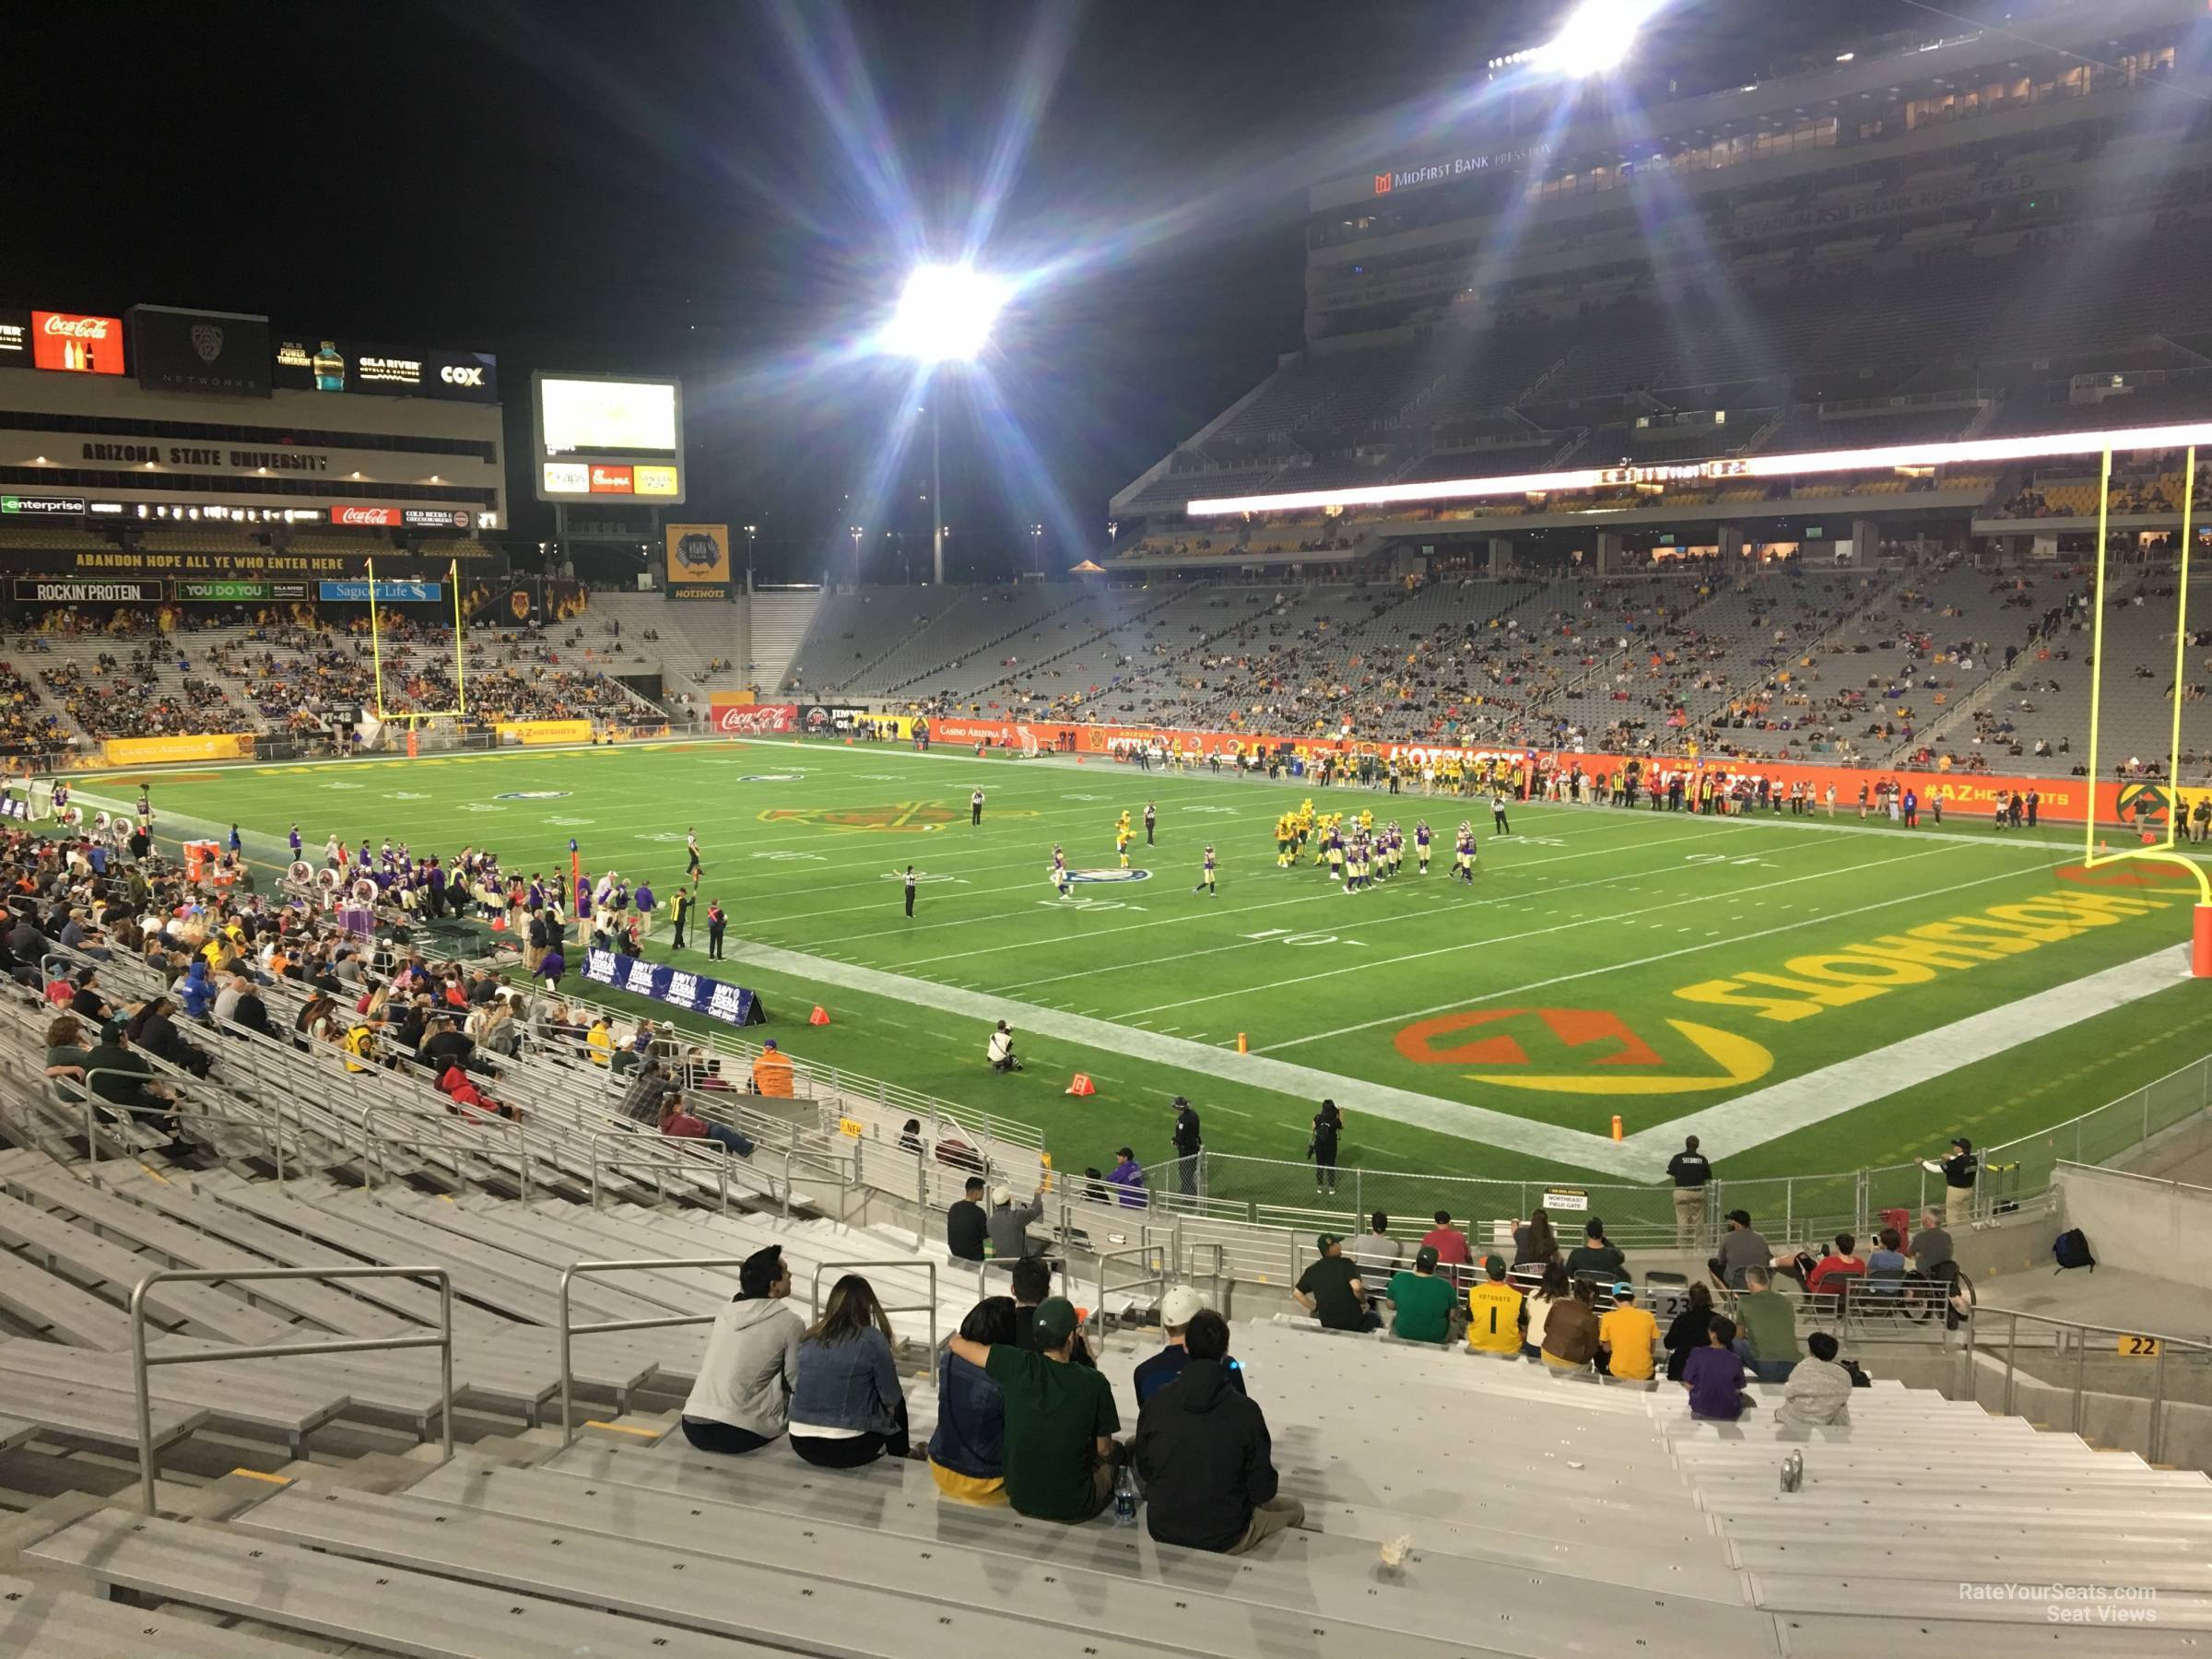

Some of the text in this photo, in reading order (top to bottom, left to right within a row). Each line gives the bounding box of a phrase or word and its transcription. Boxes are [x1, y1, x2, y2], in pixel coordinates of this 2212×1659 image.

[1454, 155, 1488, 174] BANK
[1980, 173, 2033, 198] FIELD
[44, 314, 110, 339] Coca-Cola
[191, 325, 224, 344] PAC
[200, 346, 216, 358] 12
[280, 347, 306, 358] POWER
[276, 356, 311, 367] THROUGH
[359, 357, 419, 371] GILA RIVER
[163, 373, 256, 390] NETWORKS
[441, 365, 482, 386] COX
[83, 442, 328, 471] ARIZONA STATE UNIVERSITY
[6, 500, 83, 512] enterprise
[343, 507, 391, 524] Coca-Cola
[76, 554, 344, 571] ABANDON HOPE ALL YE WHO ENTER HERE
[87, 584, 140, 600] PROTEIN
[186, 585, 263, 596] YOU DO YOU
[385, 584, 407, 597] Life
[676, 590, 724, 598] HOTSHOTS
[940, 724, 1000, 739] CASINO ARIZONA
[120, 744, 205, 756] CASINO ARIZONA
[632, 959, 650, 972] NAVY
[629, 970, 653, 984] FEDERAL
[673, 971, 691, 984] NAVY
[625, 982, 639, 993] Credit
[668, 981, 697, 996] FEDERAL
[715, 982, 734, 997] NAVY
[665, 993, 680, 1006] Credit
[712, 994, 740, 1009] FEDERAL
[708, 1006, 723, 1018] Credit
[1548, 1194, 1583, 1203] NORTHEAST
[1478, 1294, 1511, 1303] HOTSHOTS
[1666, 1297, 1690, 1315] 23
[1490, 1306, 1498, 1335] 1
[2129, 1337, 2156, 1356] 22
